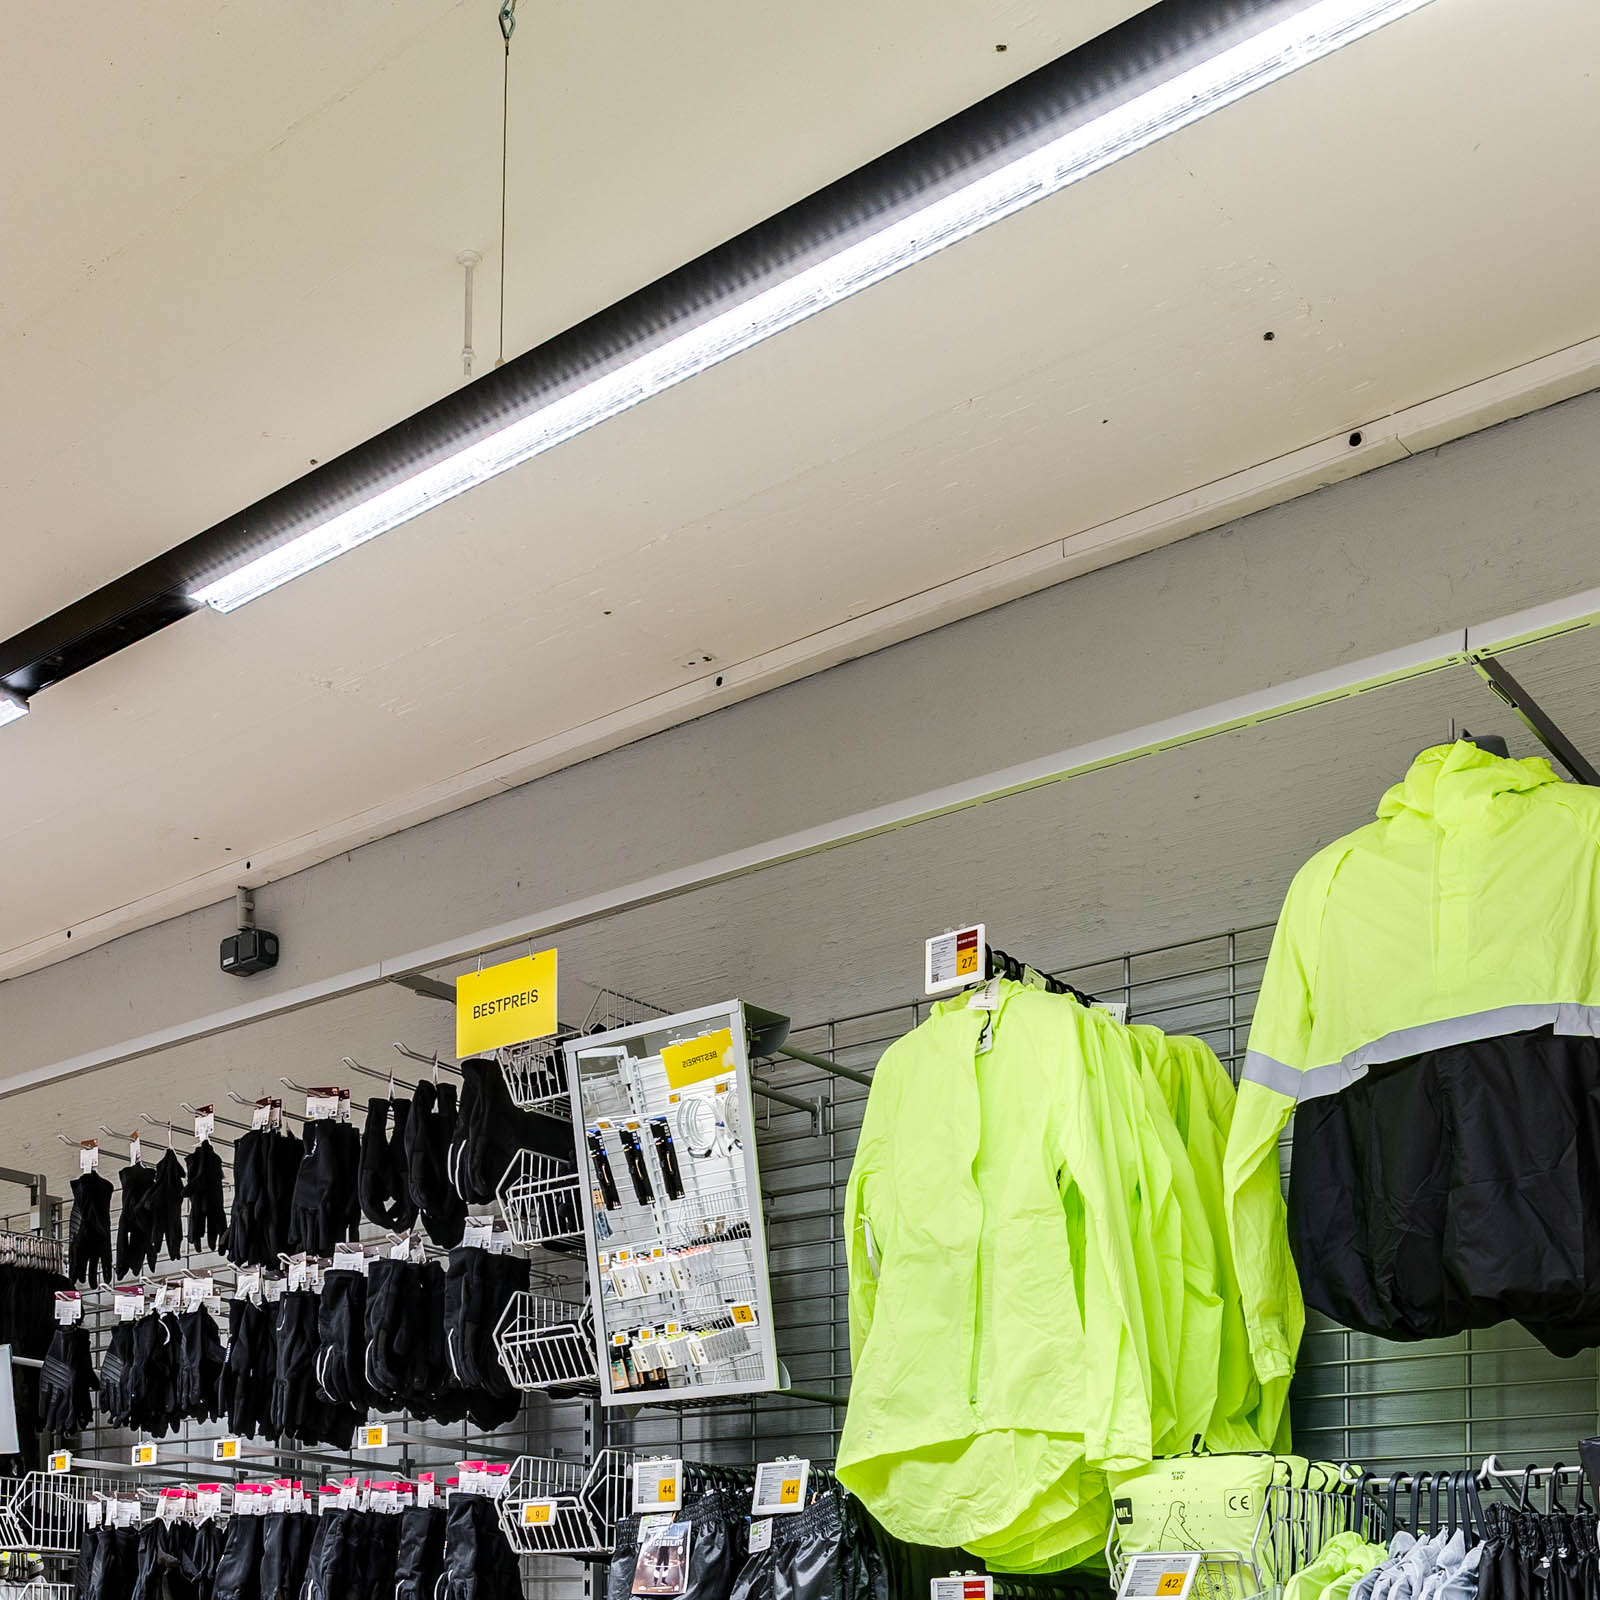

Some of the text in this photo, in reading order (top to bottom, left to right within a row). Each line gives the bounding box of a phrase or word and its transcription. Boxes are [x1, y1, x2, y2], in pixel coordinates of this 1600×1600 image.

[961, 957, 973, 969] 27
[473, 989, 539, 1019] BESTPREIS
[662, 1485, 672, 1494] 44
[786, 1486, 795, 1496] 44
[1228, 1496, 1249, 1511] CE
[1116, 1507, 1131, 1519] M/L
[1164, 1578, 1178, 1589] 42
